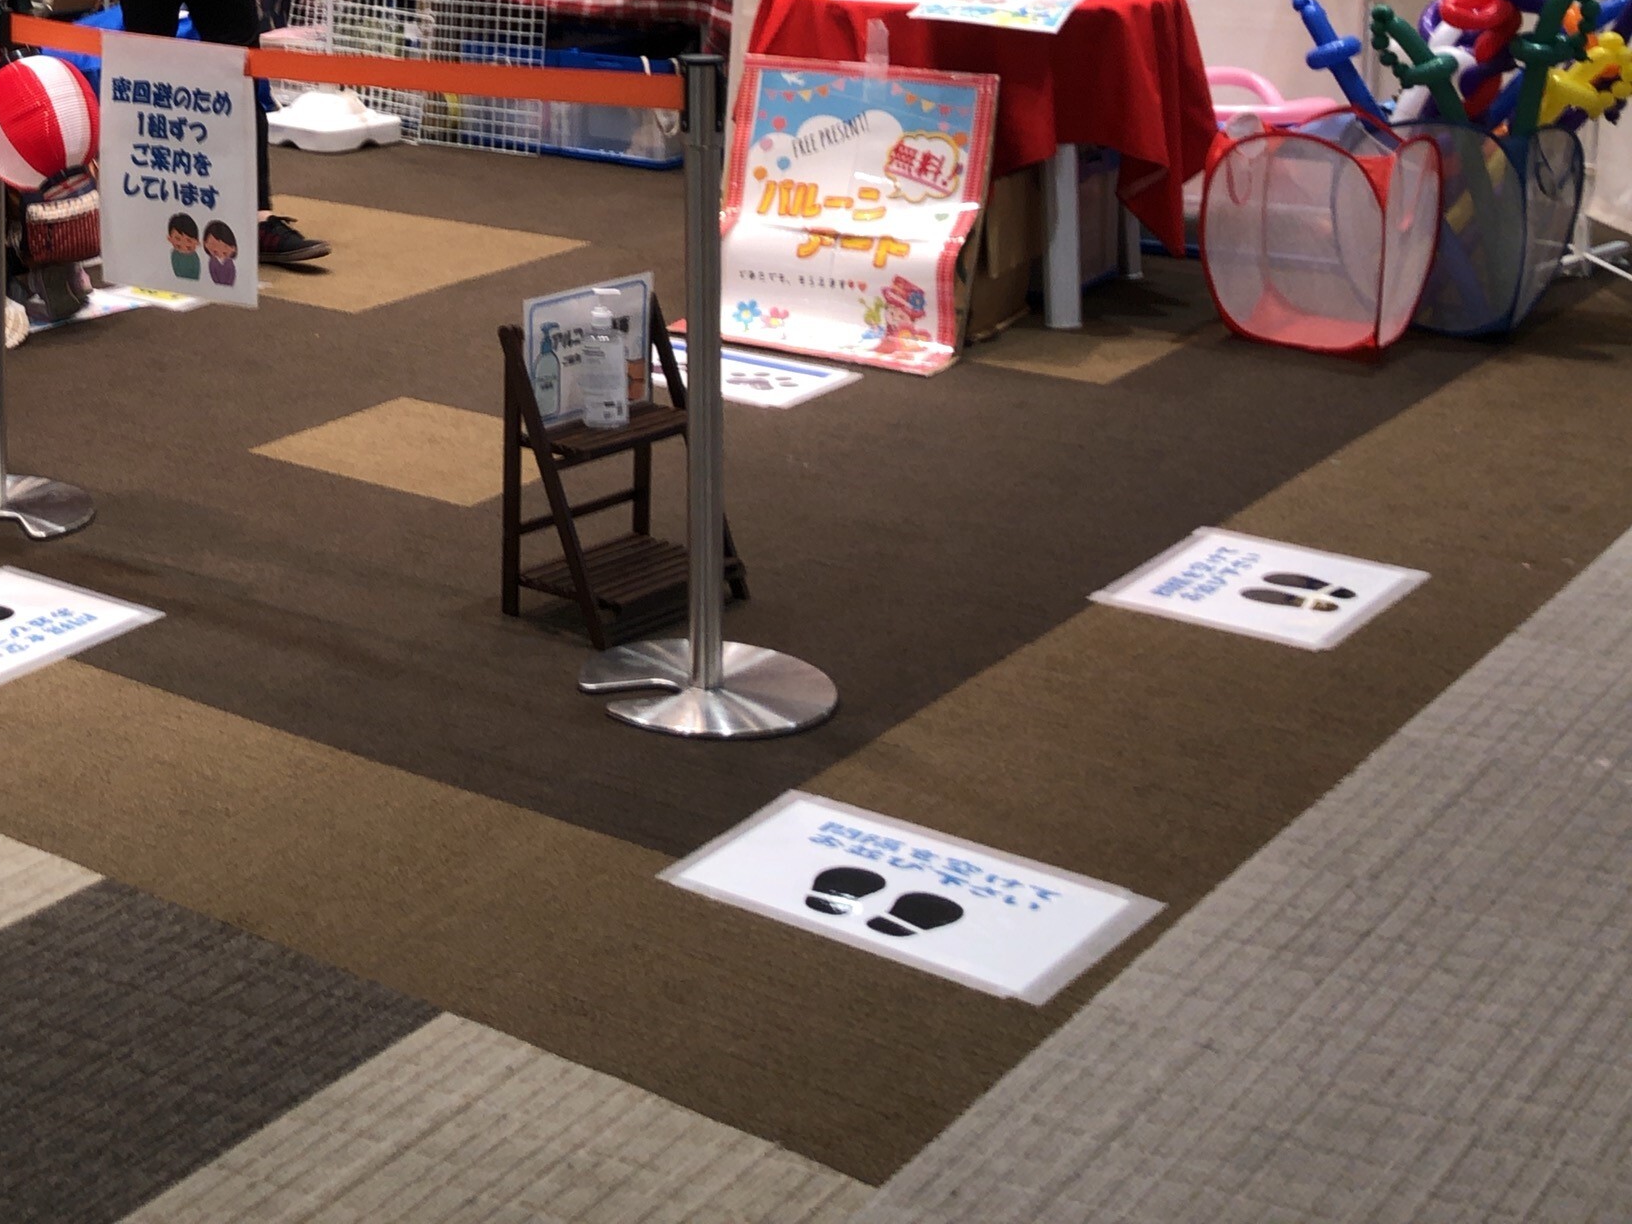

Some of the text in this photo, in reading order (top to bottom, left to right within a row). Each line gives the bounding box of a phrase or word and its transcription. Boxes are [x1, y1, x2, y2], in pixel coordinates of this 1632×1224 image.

[111, 76, 233, 117] 密回避のため
[131, 143, 212, 177] ご案内を
[791, 133, 818, 159] FREE
[123, 172, 219, 210] しています
[808, 832, 1044, 911] お並び下さい
